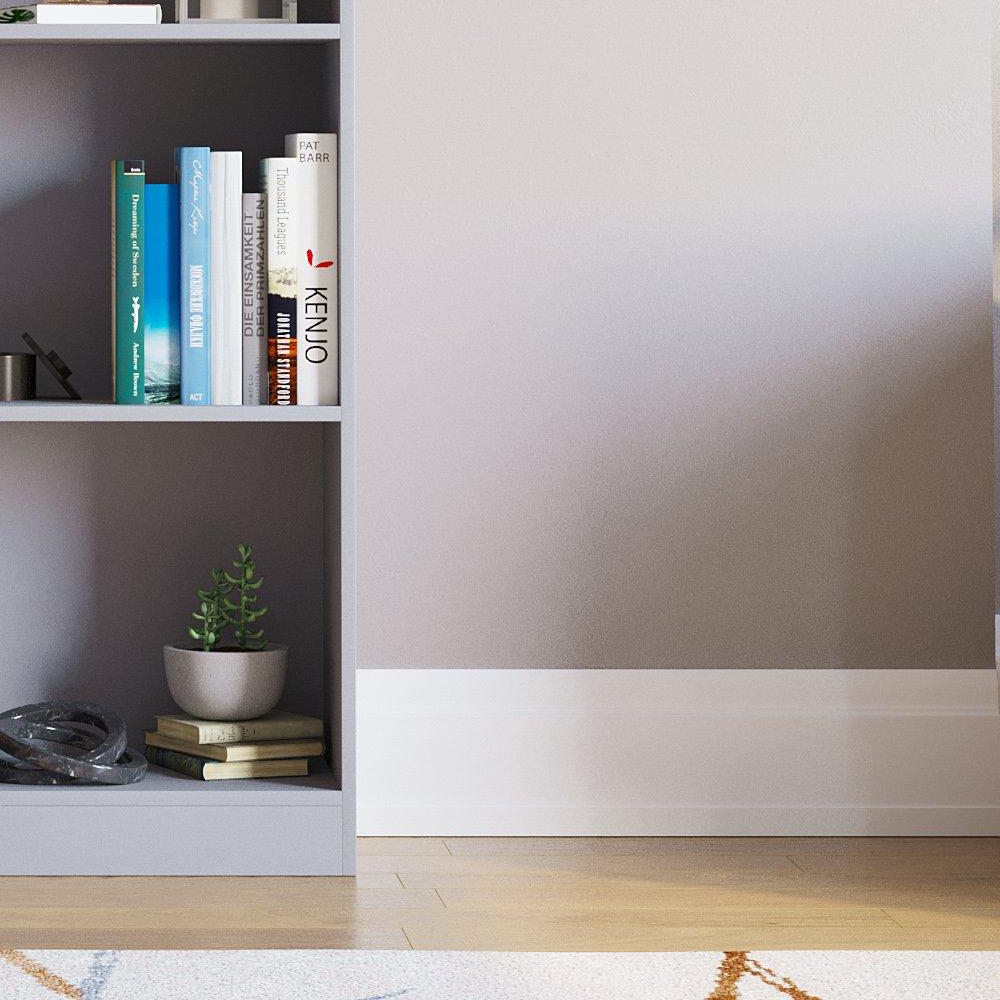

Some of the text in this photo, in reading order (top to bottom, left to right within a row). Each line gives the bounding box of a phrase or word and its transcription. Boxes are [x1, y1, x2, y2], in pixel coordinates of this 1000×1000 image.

[299, 141, 320, 150] PAT
[299, 153, 330, 163] BARR
[131, 194, 140, 287] Dreaming of Sweden
[274, 167, 289, 255] Thousand Leagues
[244, 212, 254, 337] DIE EINSAMKEIT
[256, 199, 265, 337] DER PRIMZAHLEN
[132, 341, 140, 396] Andrew Brown
[277, 312, 291, 405] JONATHAN STANDFORD
[305, 287, 328, 364] KENJO
